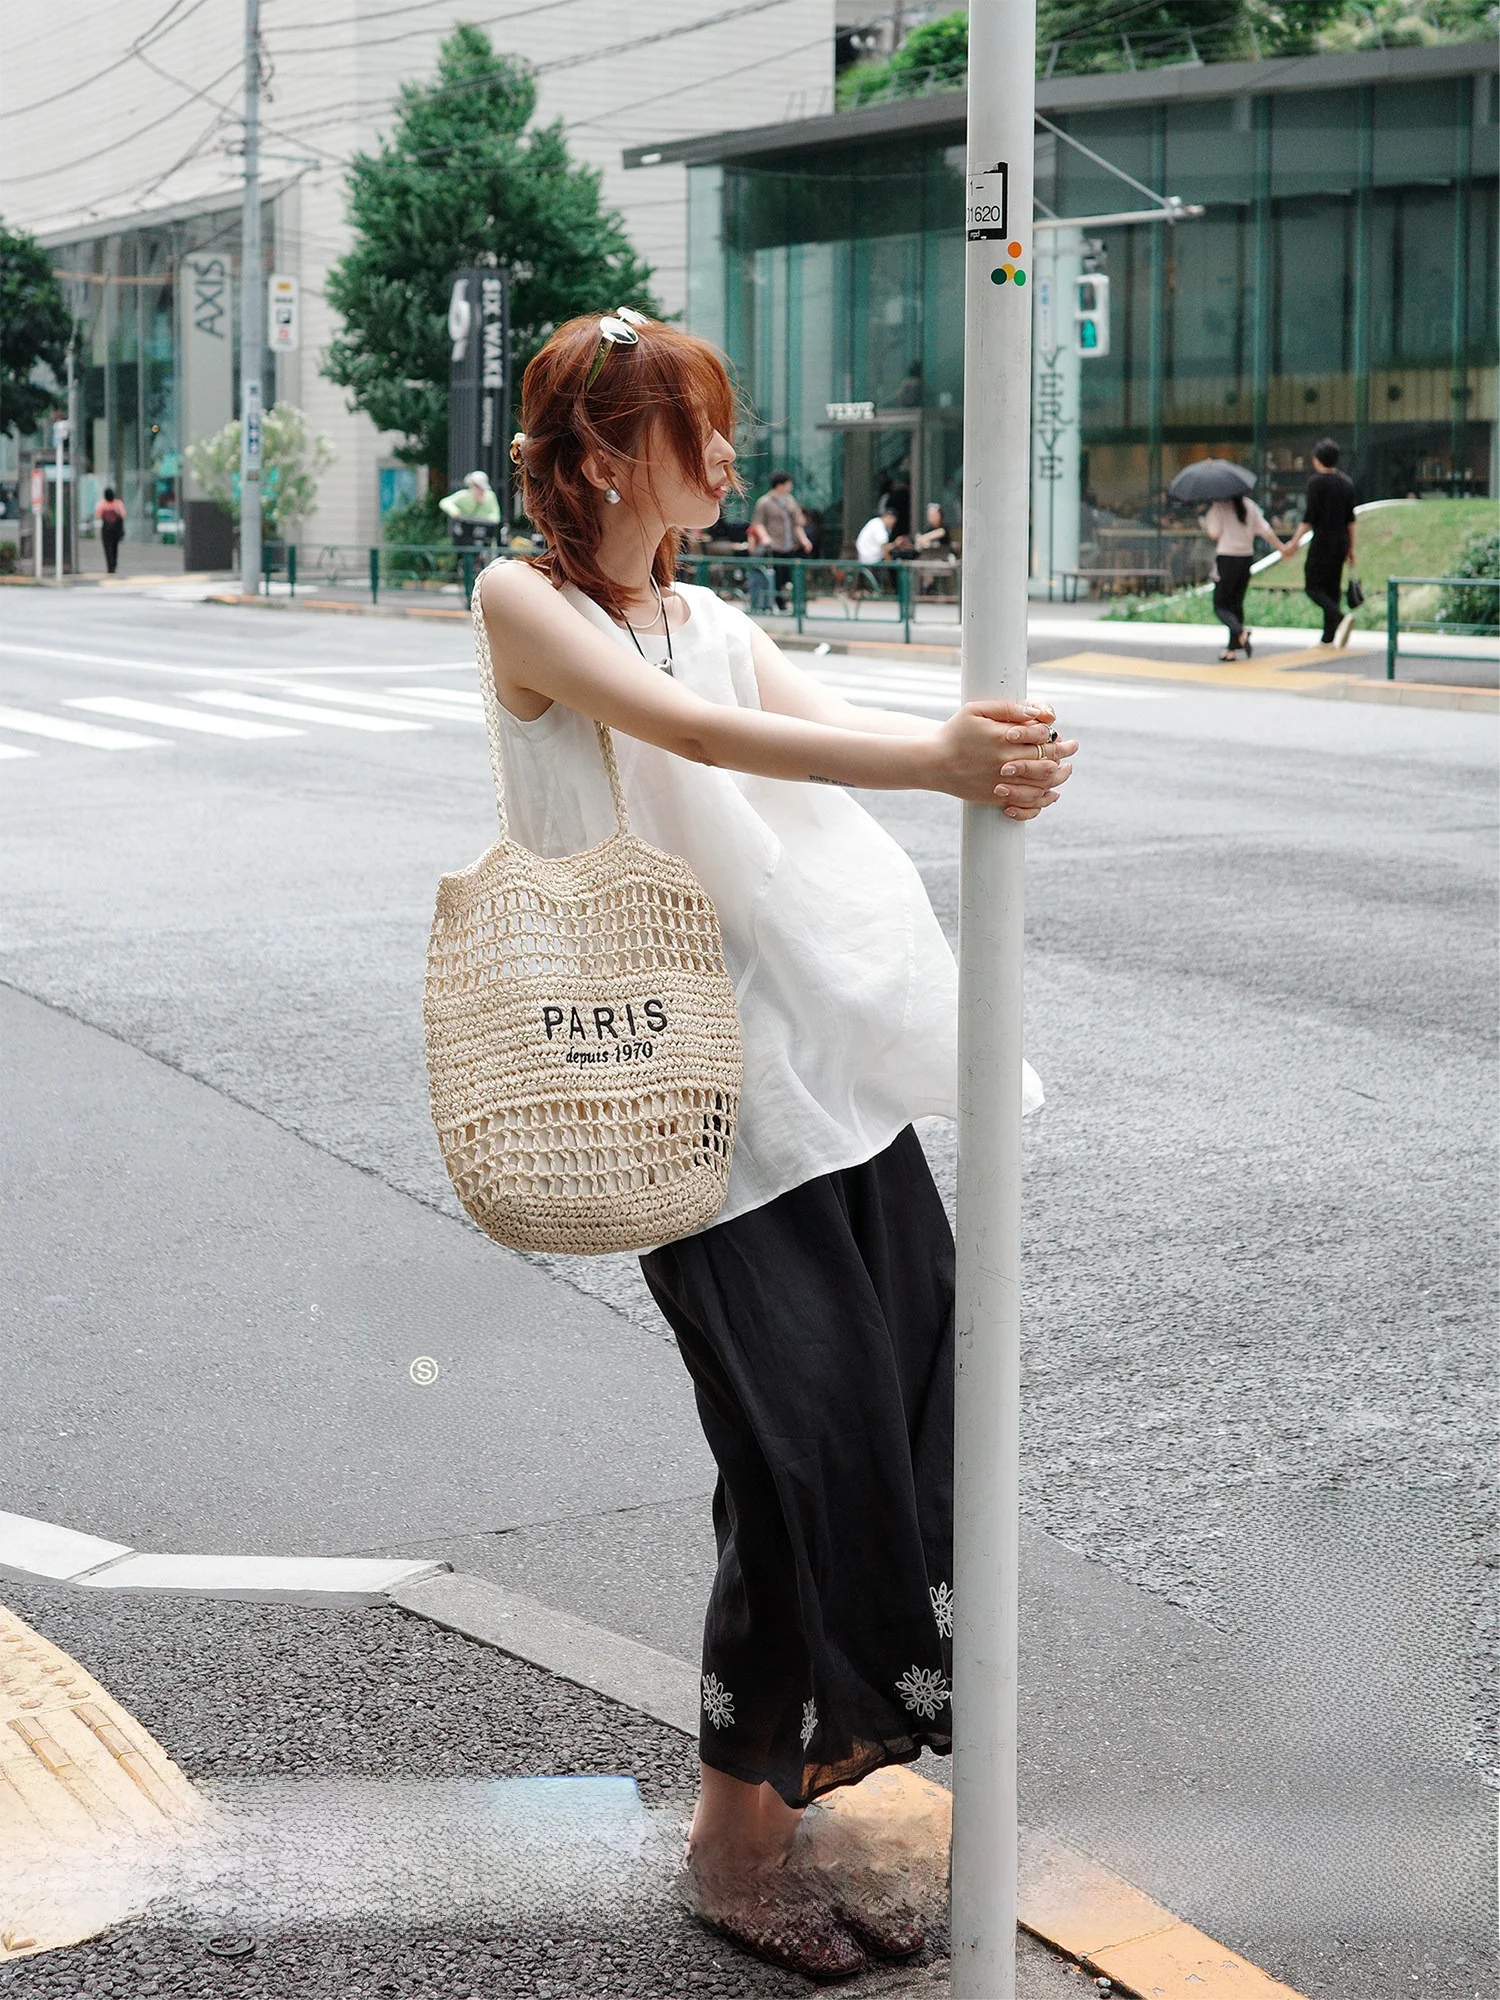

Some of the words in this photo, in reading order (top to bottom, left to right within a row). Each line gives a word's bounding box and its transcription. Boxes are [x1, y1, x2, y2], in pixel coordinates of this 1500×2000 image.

[194, 260, 224, 339] AXIS
[482, 278, 502, 317] SIX
[483, 322, 503, 389] WAKE
[1038, 346, 1074, 480] VERVE
[542, 998, 668, 1041] PARIS
[565, 1045, 609, 1070] depuis
[614, 1040, 653, 1063] 1970
